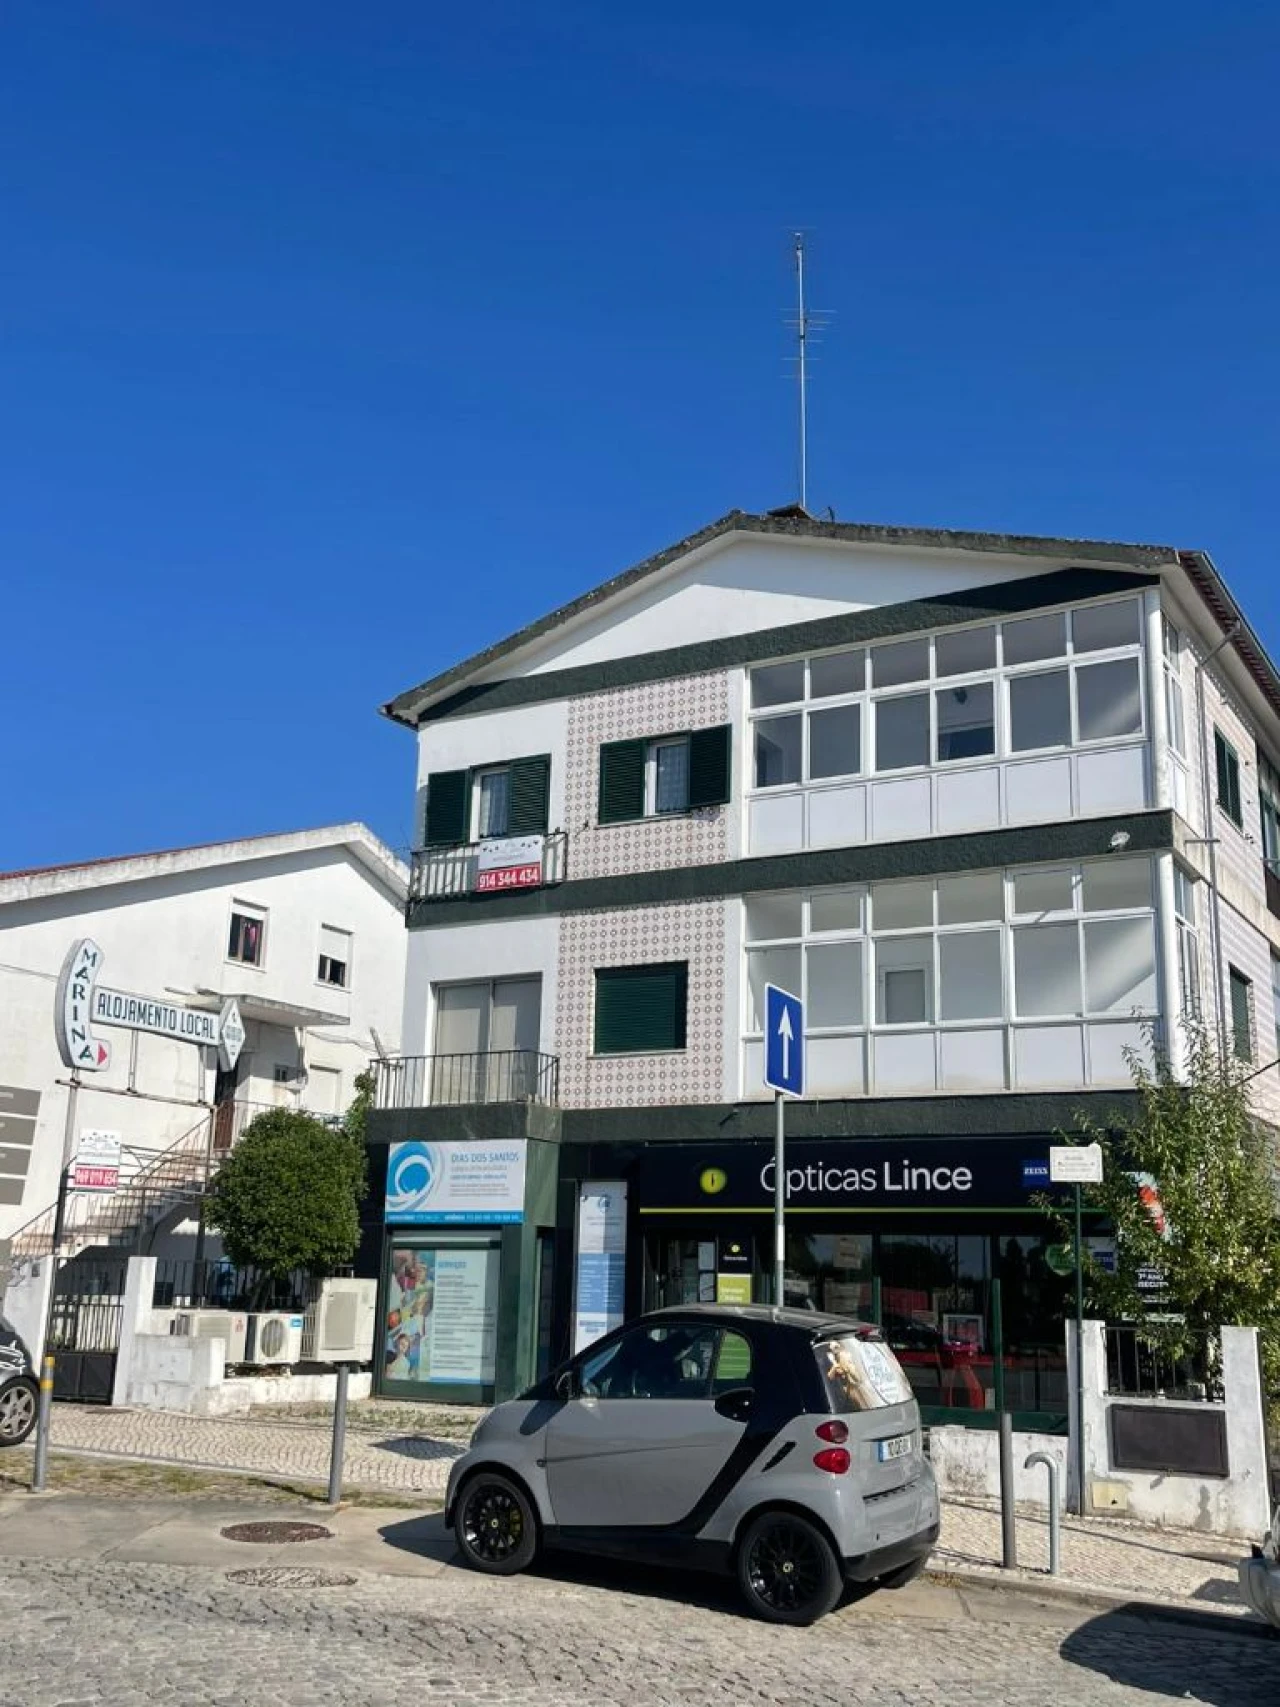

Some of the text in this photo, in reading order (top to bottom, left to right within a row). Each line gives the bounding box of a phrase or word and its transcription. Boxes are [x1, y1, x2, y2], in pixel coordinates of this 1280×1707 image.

[479, 867, 538, 888] 914 344 434
[72, 947, 98, 1061] MARINA
[98, 993, 177, 1031] ALOJAMENTO
[181, 1011, 215, 1040] LOCAL
[451, 1151, 519, 1163] DIAS DOS SANTOS
[1024, 1167, 1048, 1175] ZEISS
[760, 1156, 973, 1200] Ópticas Lince
